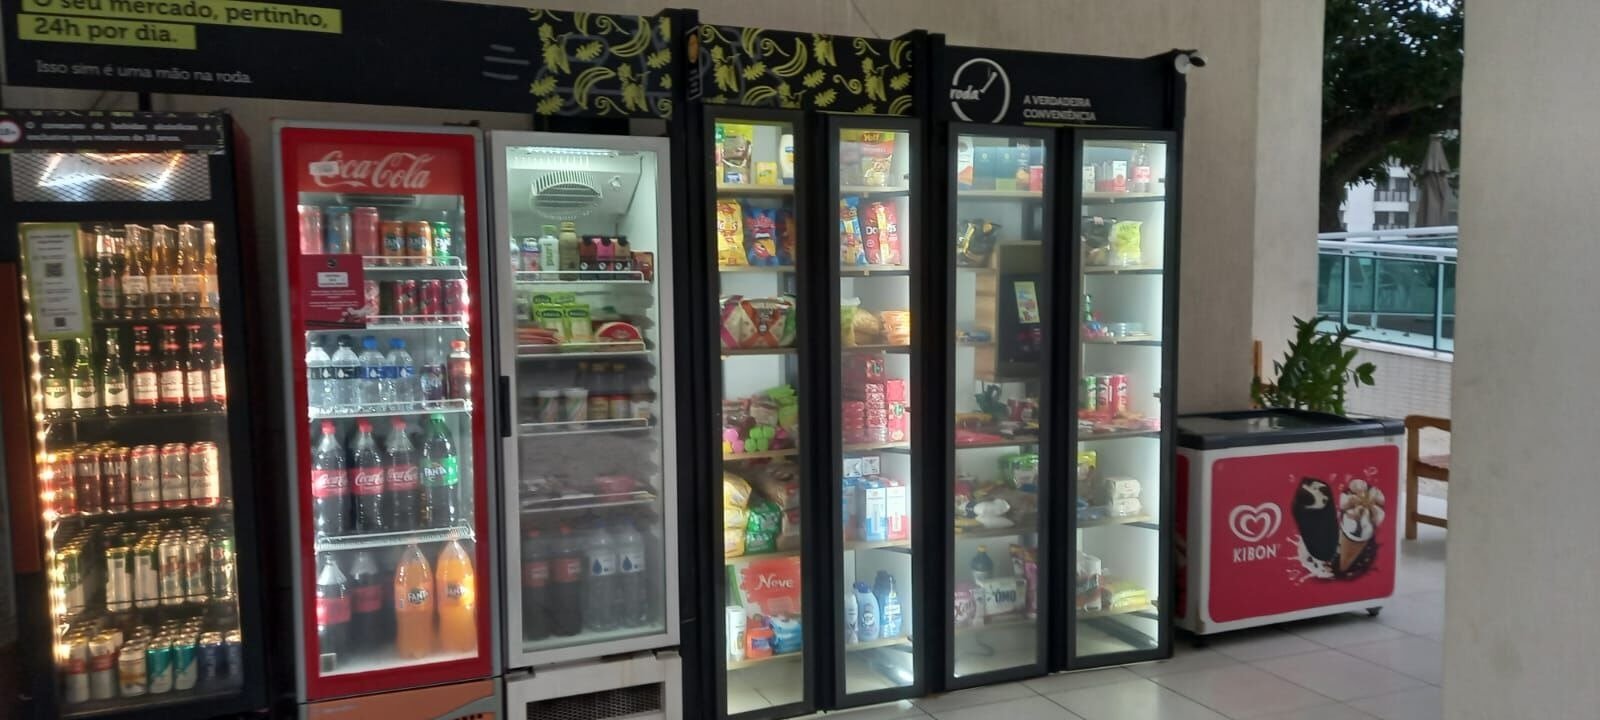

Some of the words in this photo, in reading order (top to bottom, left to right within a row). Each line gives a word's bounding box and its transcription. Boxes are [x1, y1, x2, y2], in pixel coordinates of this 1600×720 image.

[110, 0, 218, 20] mercado,
[225, 7, 328, 29] pertinho,
[34, 17, 81, 37] 24h
[87, 24, 129, 41] por
[135, 24, 177, 43] dia.
[35, 60, 69, 73] Isso
[72, 62, 100, 75] sim
[103, 64, 114, 76] é
[117, 66, 153, 78] uma
[155, 67, 191, 80] mão
[193, 71, 214, 81] na
[949, 85, 980, 101] roda
[1023, 95, 1033, 105] A
[1034, 96, 1091, 108] VERDADEIRA
[1023, 107, 1097, 121] CONVENIÊNCIA
[1232, 545, 1277, 563] KIBON
